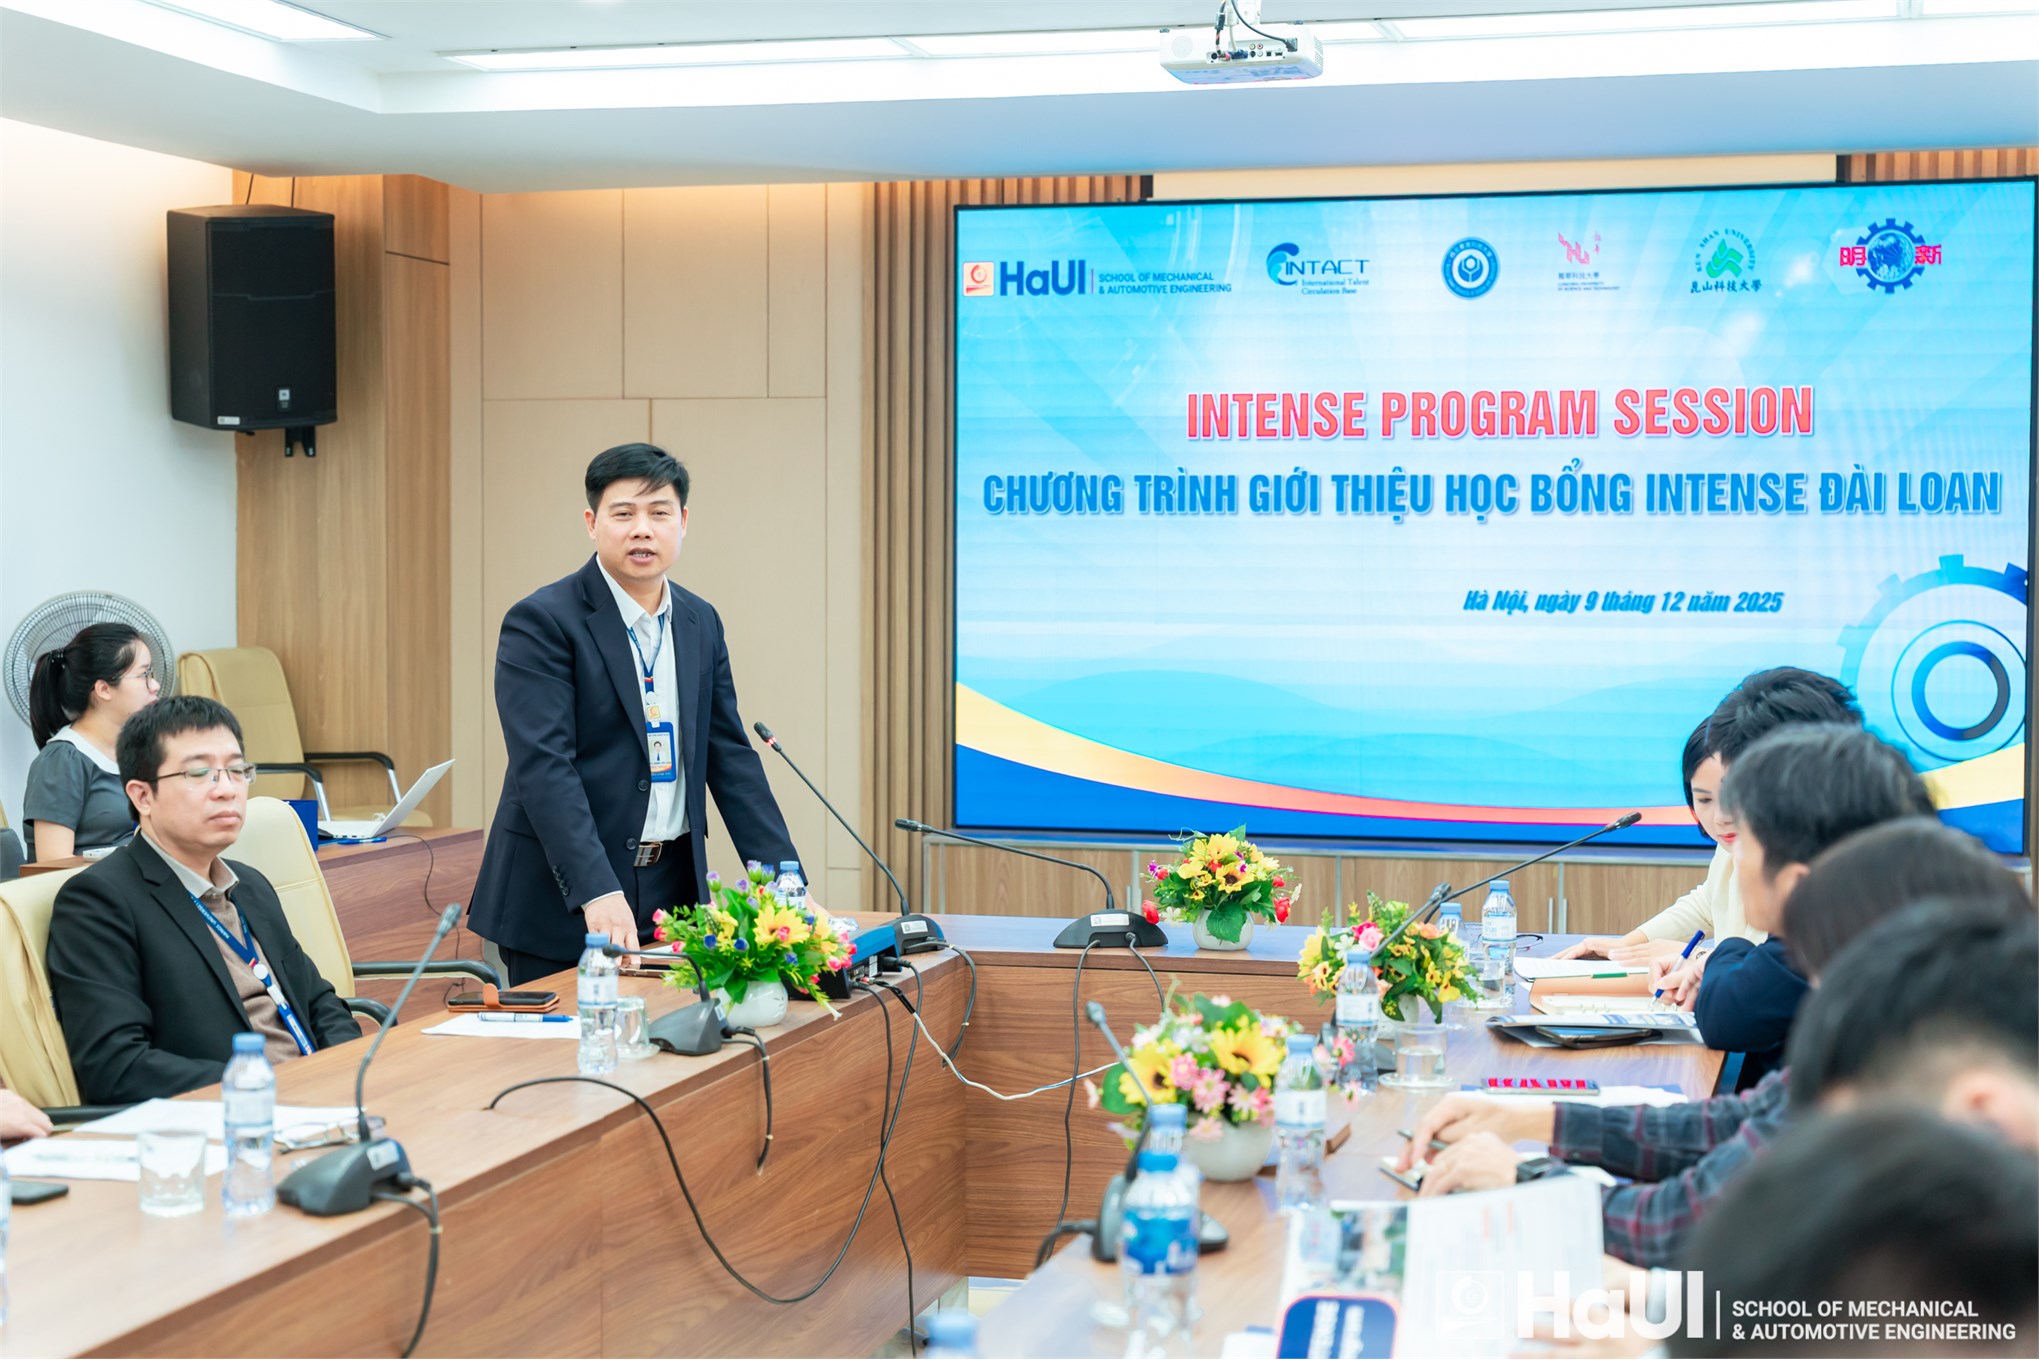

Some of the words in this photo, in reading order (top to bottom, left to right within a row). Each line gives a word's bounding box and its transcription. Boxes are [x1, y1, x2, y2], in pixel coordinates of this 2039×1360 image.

[1699, 229, 1721, 248] SHAN
[1840, 246, 1867, 267] 明
[1000, 260, 1086, 296] HaUI
[1098, 272, 1136, 284] SCHOOL
[1138, 272, 1152, 283] OF
[1152, 271, 1215, 282] MECHANICAL
[1301, 278, 1346, 287] International
[1347, 277, 1370, 286] Talent
[1098, 285, 1106, 295] &
[1107, 284, 1169, 295] AUTOMOTIVE
[1169, 283, 1232, 294] ENGINEERING
[1301, 287, 1341, 296] Circulation
[1341, 286, 1358, 295] Base
[1187, 391, 1367, 440] INTENSE
[1380, 389, 1597, 439] PROGRAM
[1613, 386, 1814, 436] SESSION
[983, 471, 1123, 515] CHƯƠNG
[1133, 466, 1237, 514] TRÌNH
[1248, 466, 1320, 514] GIỚI
[1331, 466, 1433, 523] THIỆU
[1445, 473, 1519, 522] HỌC
[1530, 457, 1632, 514] BỔNG
[1645, 472, 1808, 514] INTENSE
[1819, 463, 1886, 513] ĐÀI
[1898, 471, 2000, 513] LOAN
[1463, 590, 1489, 611] Hà
[1492, 590, 1529, 615] Nội,
[1533, 589, 1582, 614] ngày
[1583, 590, 1600, 612] 9
[1601, 589, 1656, 614] tháng
[1662, 591, 1686, 612] 12
[1687, 590, 1732, 612] năm
[1732, 591, 1785, 613] 2025
